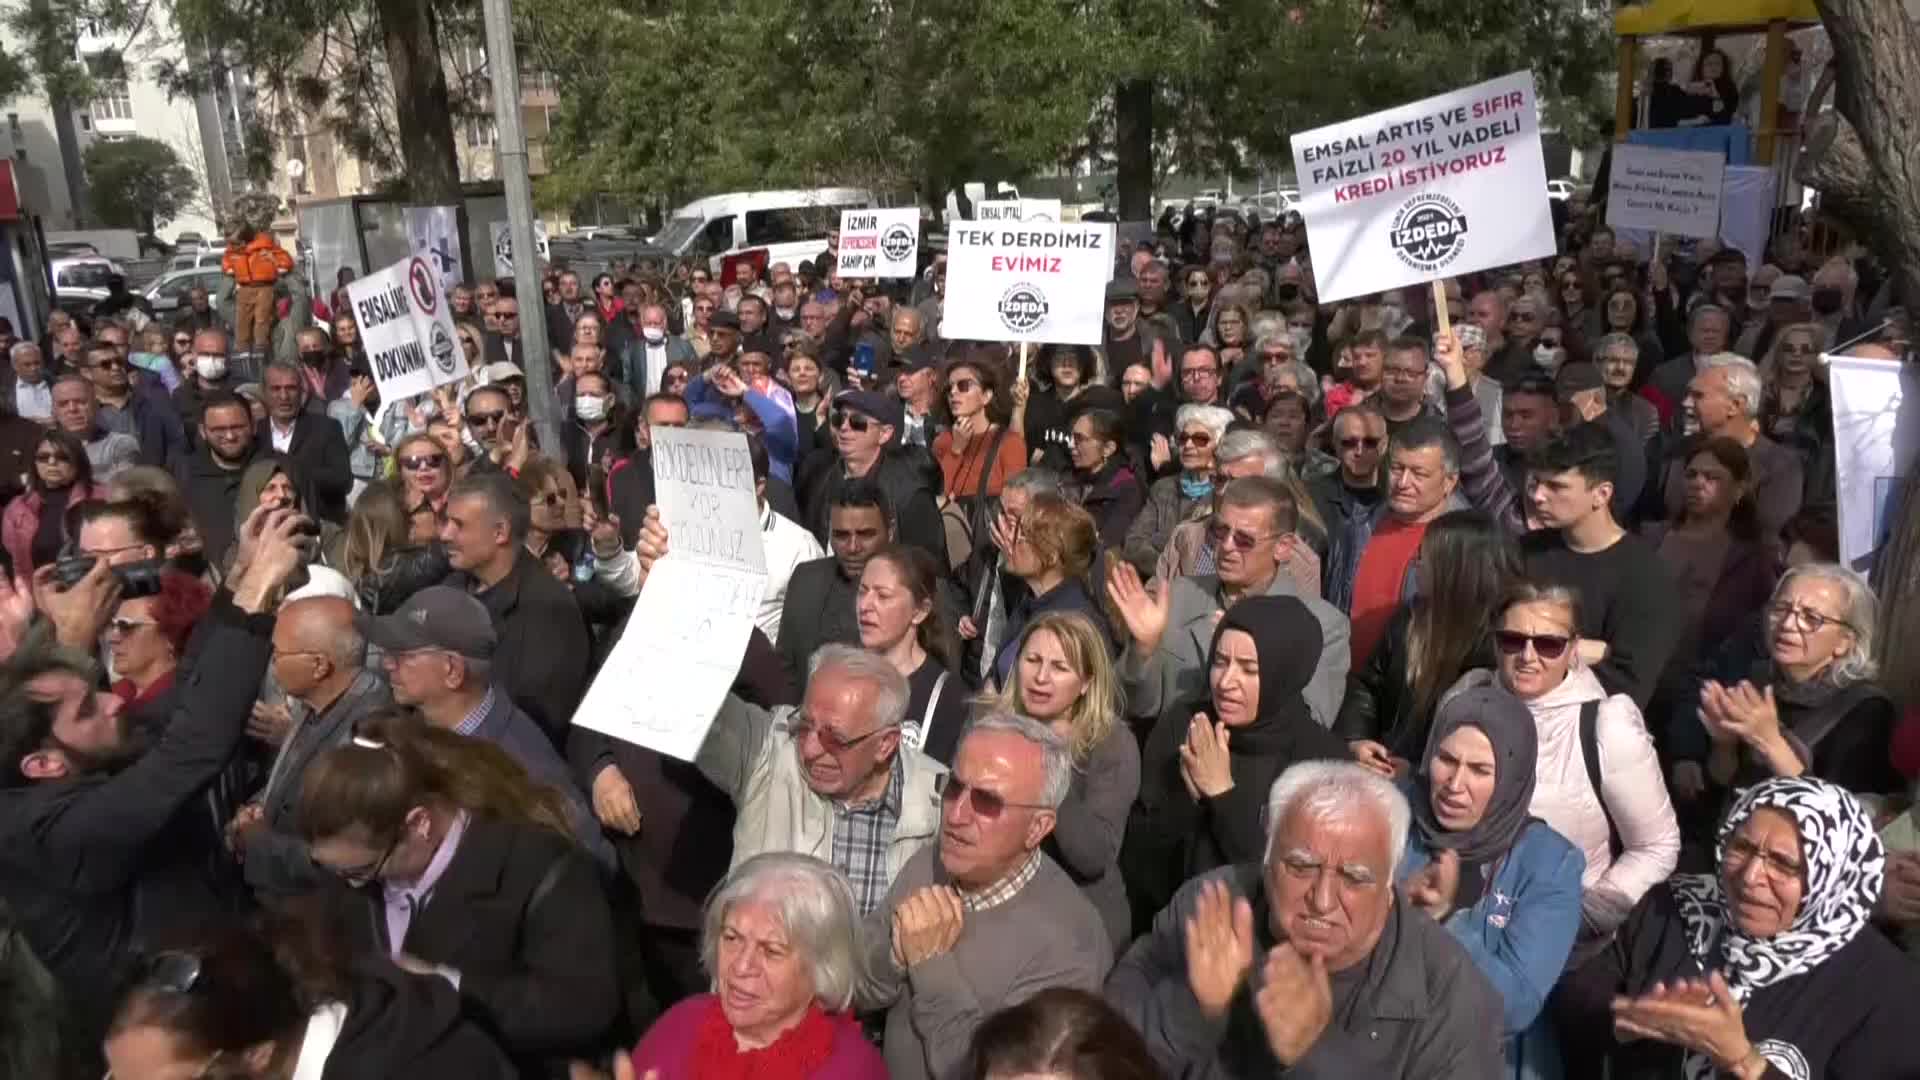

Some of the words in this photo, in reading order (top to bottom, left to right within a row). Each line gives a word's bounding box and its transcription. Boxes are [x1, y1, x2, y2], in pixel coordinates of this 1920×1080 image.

[1303, 135, 1370, 163] EMSAL
[1376, 114, 1435, 145] ARTIŞ
[1440, 107, 1467, 127] VE
[1472, 91, 1524, 119] SIFIR
[1312, 154, 1375, 184] FAİZLİ
[1381, 150, 1405, 168] 20
[1412, 142, 1444, 158] YIL
[1449, 112, 1521, 149] VADELİ
[1335, 175, 1394, 204] KREDİ
[1400, 147, 1506, 187] İSTİYORUZ
[848, 212, 877, 231] İZMİR
[957, 230, 995, 246] TEK
[1002, 229, 1102, 248] DERDİMİZ
[991, 251, 1062, 272] EVİMİZ
